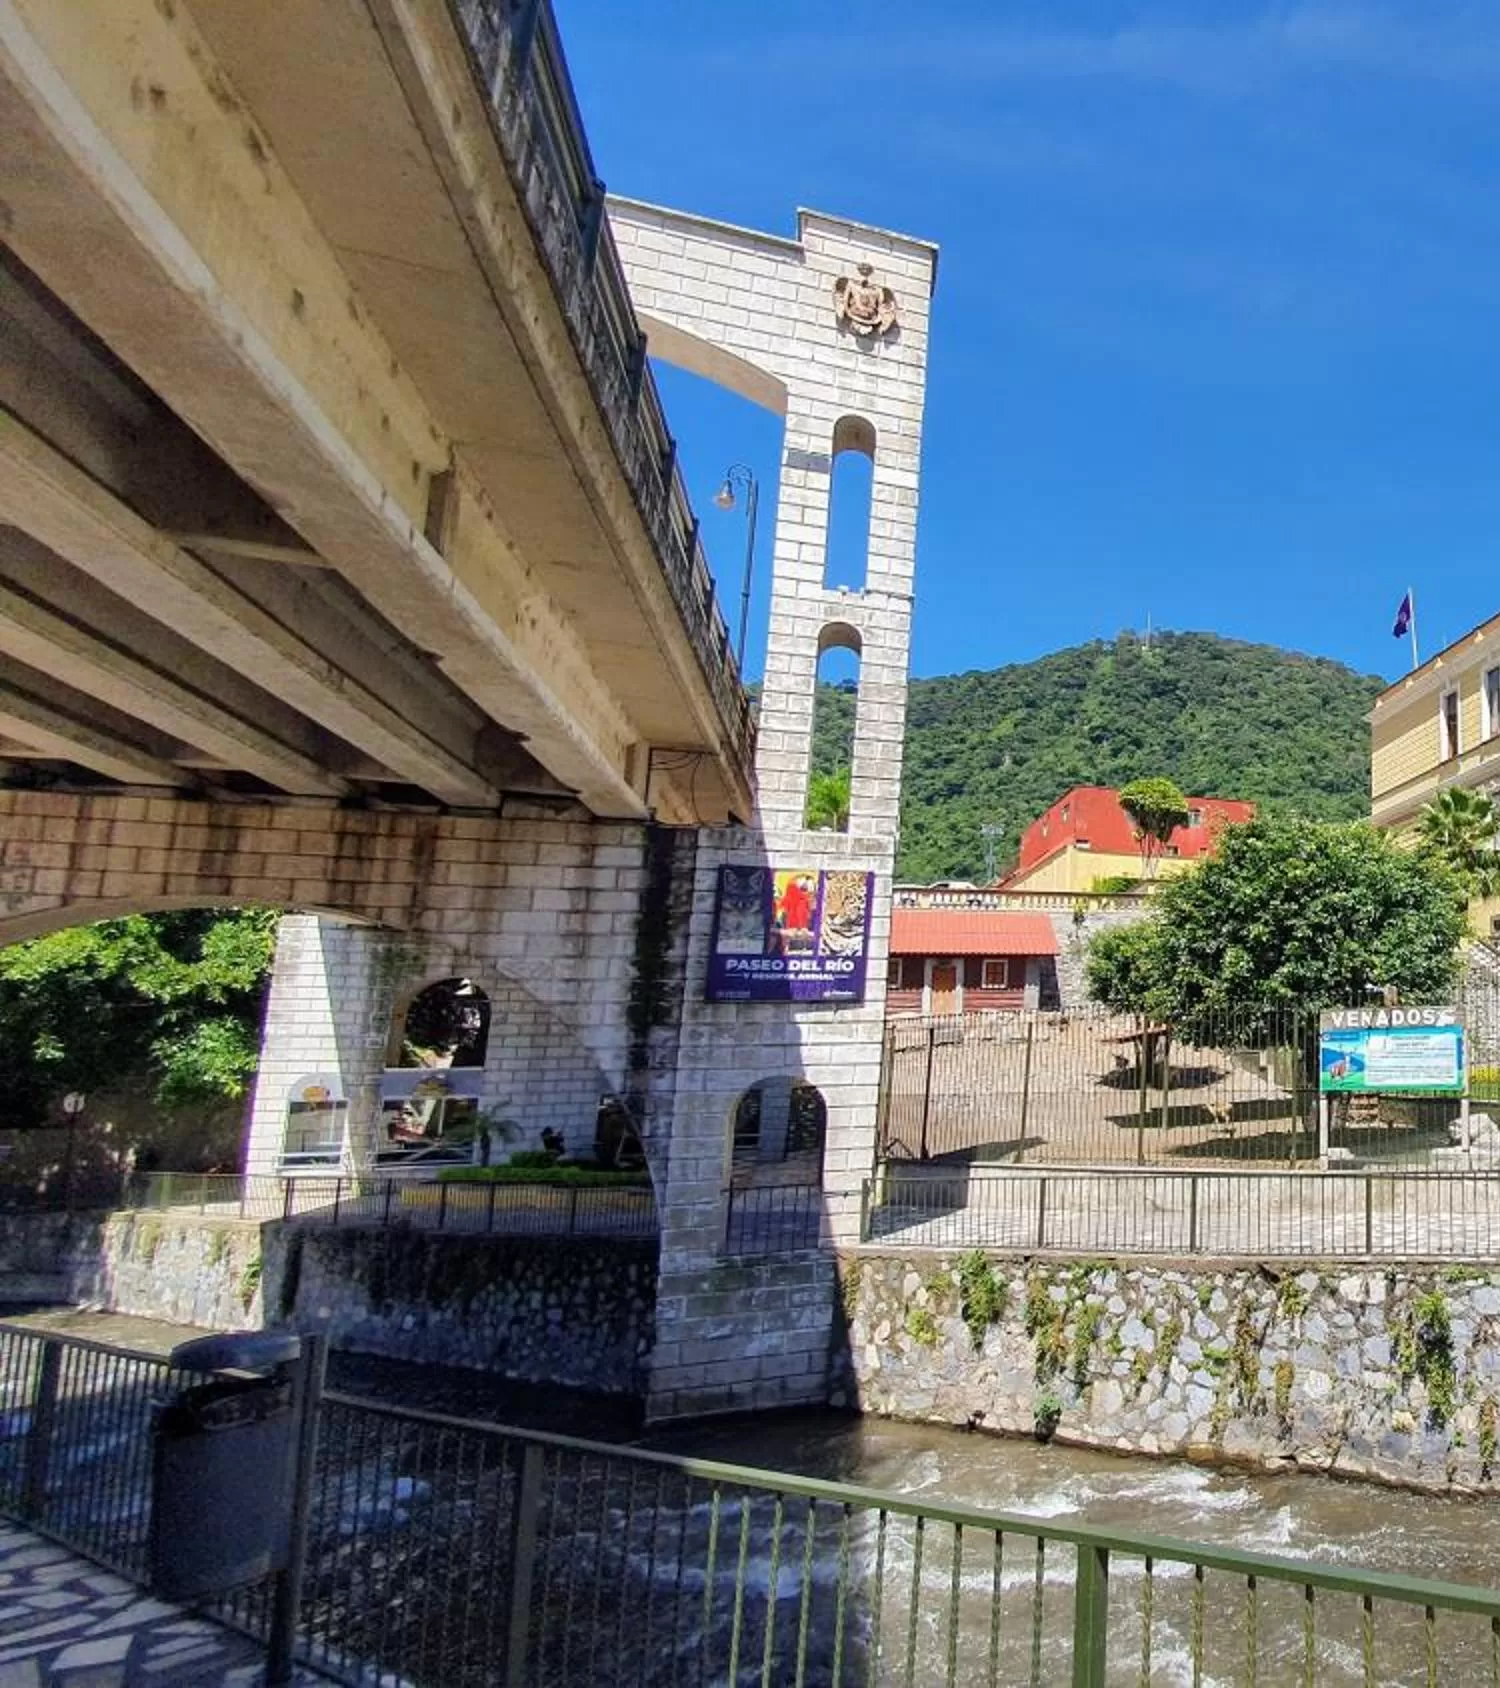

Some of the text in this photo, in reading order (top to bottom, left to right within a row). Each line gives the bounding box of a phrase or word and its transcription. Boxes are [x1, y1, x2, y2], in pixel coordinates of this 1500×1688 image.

[726, 957, 855, 971] PASEO DEL RÍO
[1332, 1010, 1435, 1026] VENADOS
